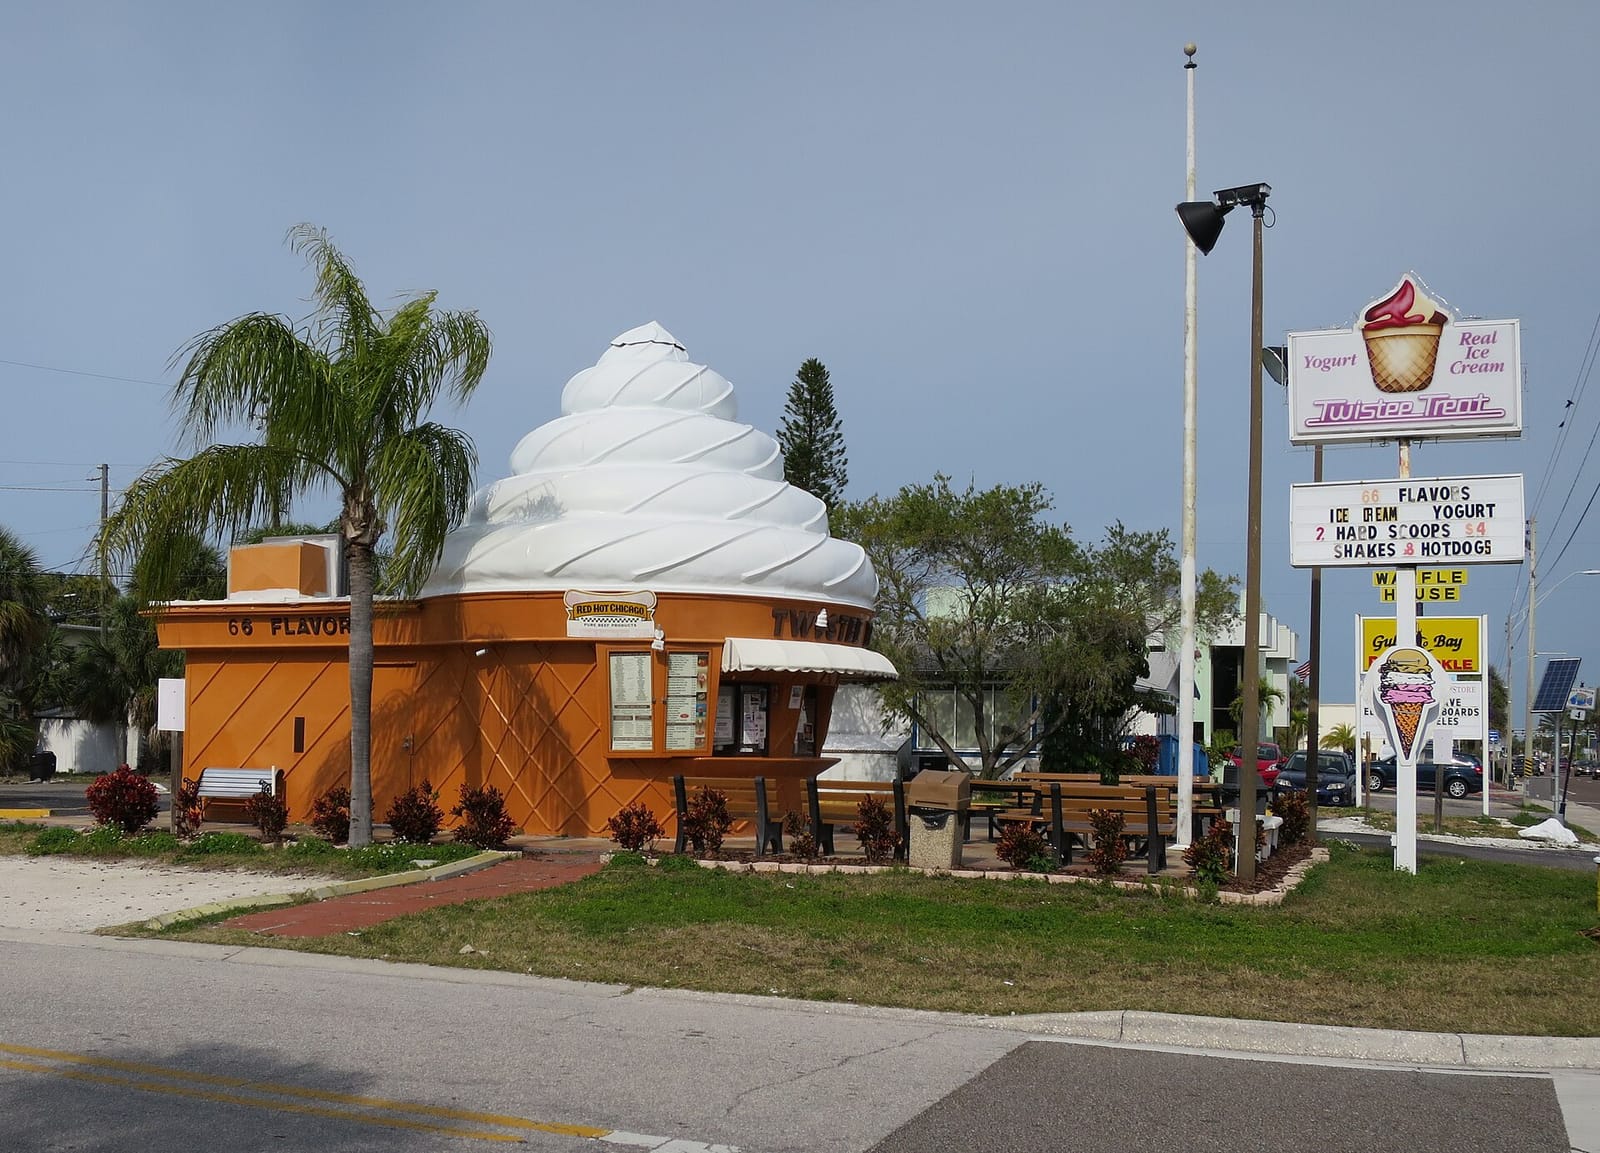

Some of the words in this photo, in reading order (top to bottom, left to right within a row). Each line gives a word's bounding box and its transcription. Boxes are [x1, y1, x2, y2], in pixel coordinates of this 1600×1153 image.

[1459, 331, 1498, 346] Real
[1465, 347, 1490, 359] Ice
[1303, 353, 1358, 372] Yogurt
[1450, 360, 1505, 375] Cream
[1313, 398, 1414, 422] Twistee
[1417, 393, 1491, 417] Treat
[1361, 489, 1380, 504] 66
[1398, 486, 1471, 503] FLAVORS
[1330, 508, 1349, 523] ICE
[1432, 503, 1496, 520] YOGURT
[1334, 543, 1396, 559] SHAKES
[1421, 540, 1492, 557] HOTDOGS
[1376, 571, 1463, 585] WFLE
[1384, 587, 1456, 601] HUSE
[576, 605, 593, 615] RED
[609, 603, 645, 615] CHICAGO
[228, 617, 253, 636] 66
[270, 615, 351, 636] FLAVOR
[1372, 635, 1397, 651] Gul
[1433, 634, 1463, 652] Bay
[1440, 659, 1473, 670] KLE
